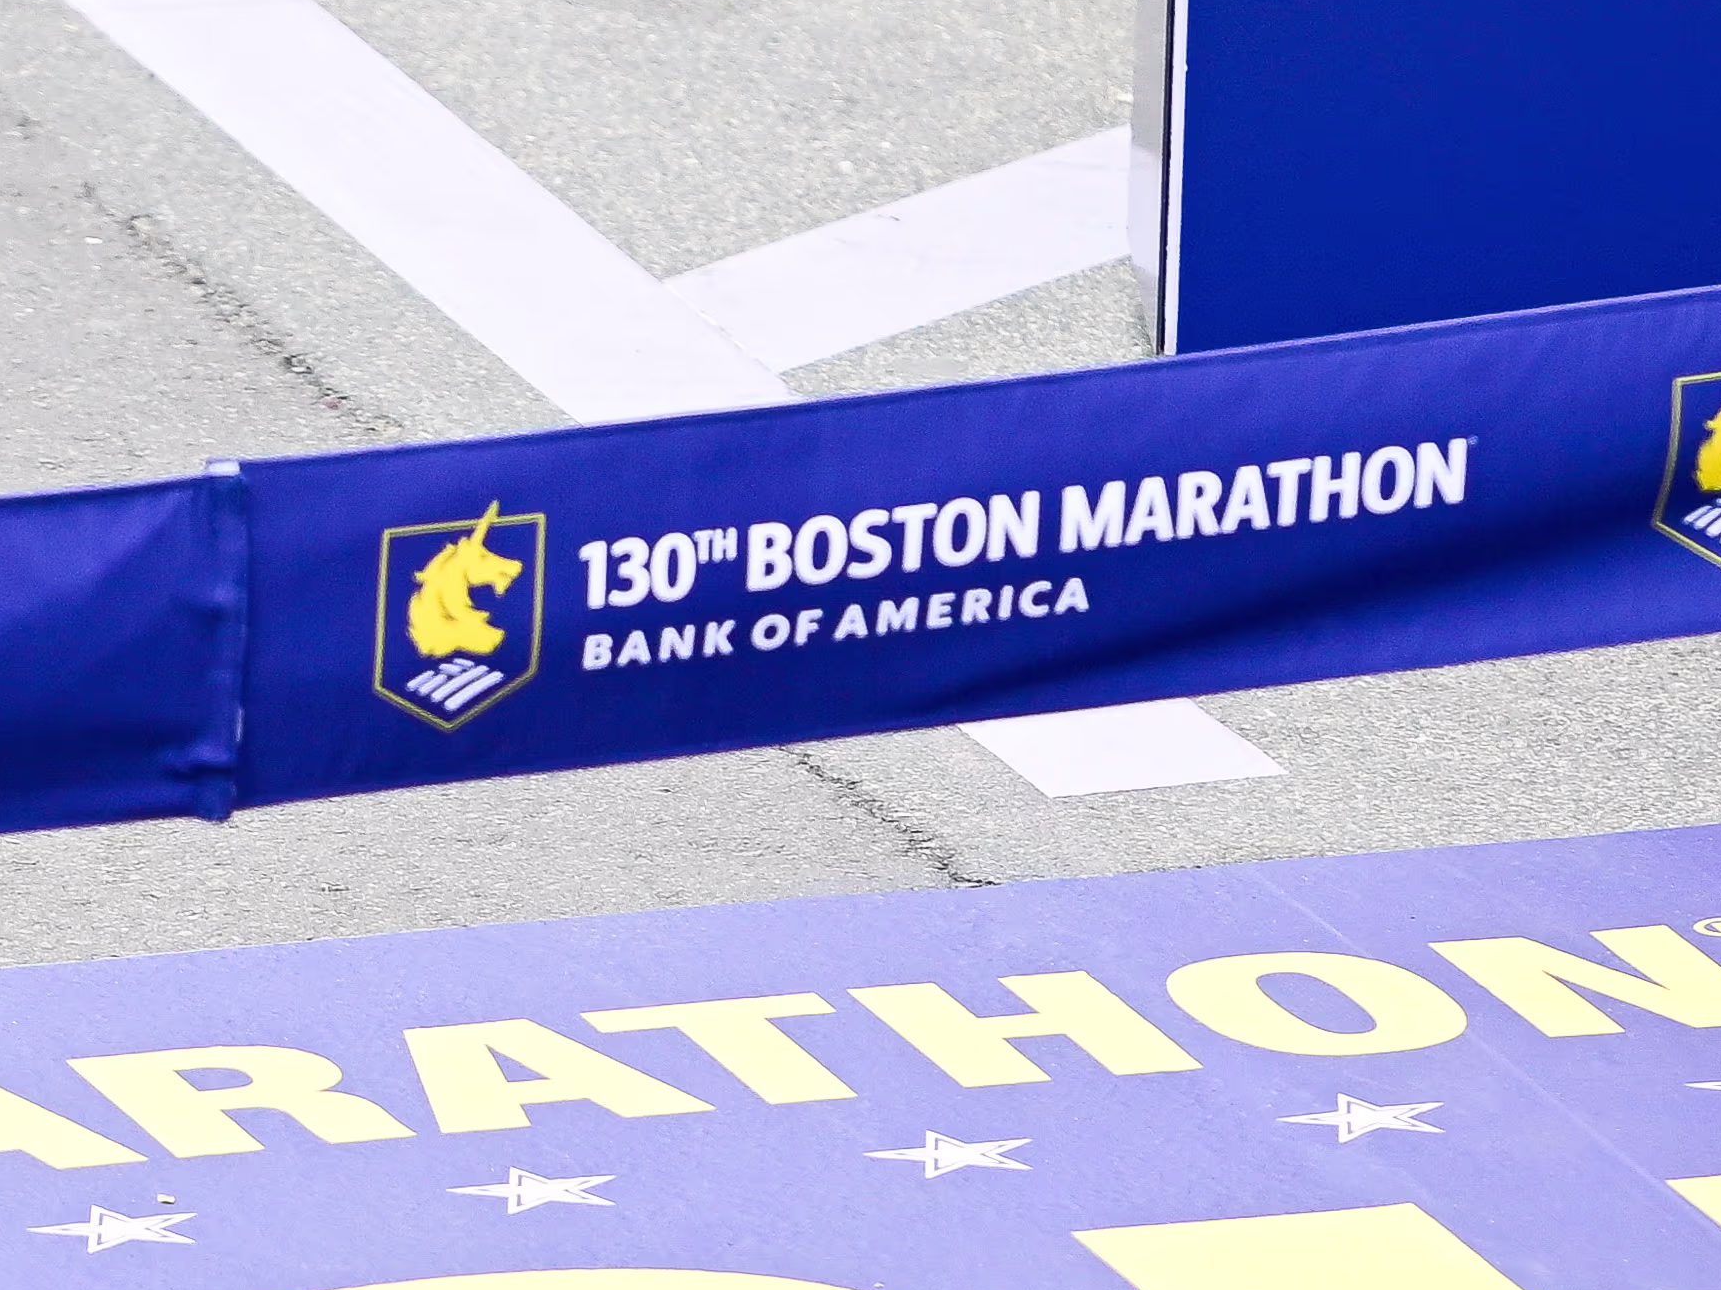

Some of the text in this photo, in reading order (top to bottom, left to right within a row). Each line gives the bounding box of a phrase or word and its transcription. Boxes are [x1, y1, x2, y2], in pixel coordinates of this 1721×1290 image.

[747, 491, 1039, 591] BOSTON
[1059, 438, 1467, 552] MARATHON
[582, 578, 1089, 670] BANK OF AMERICA
